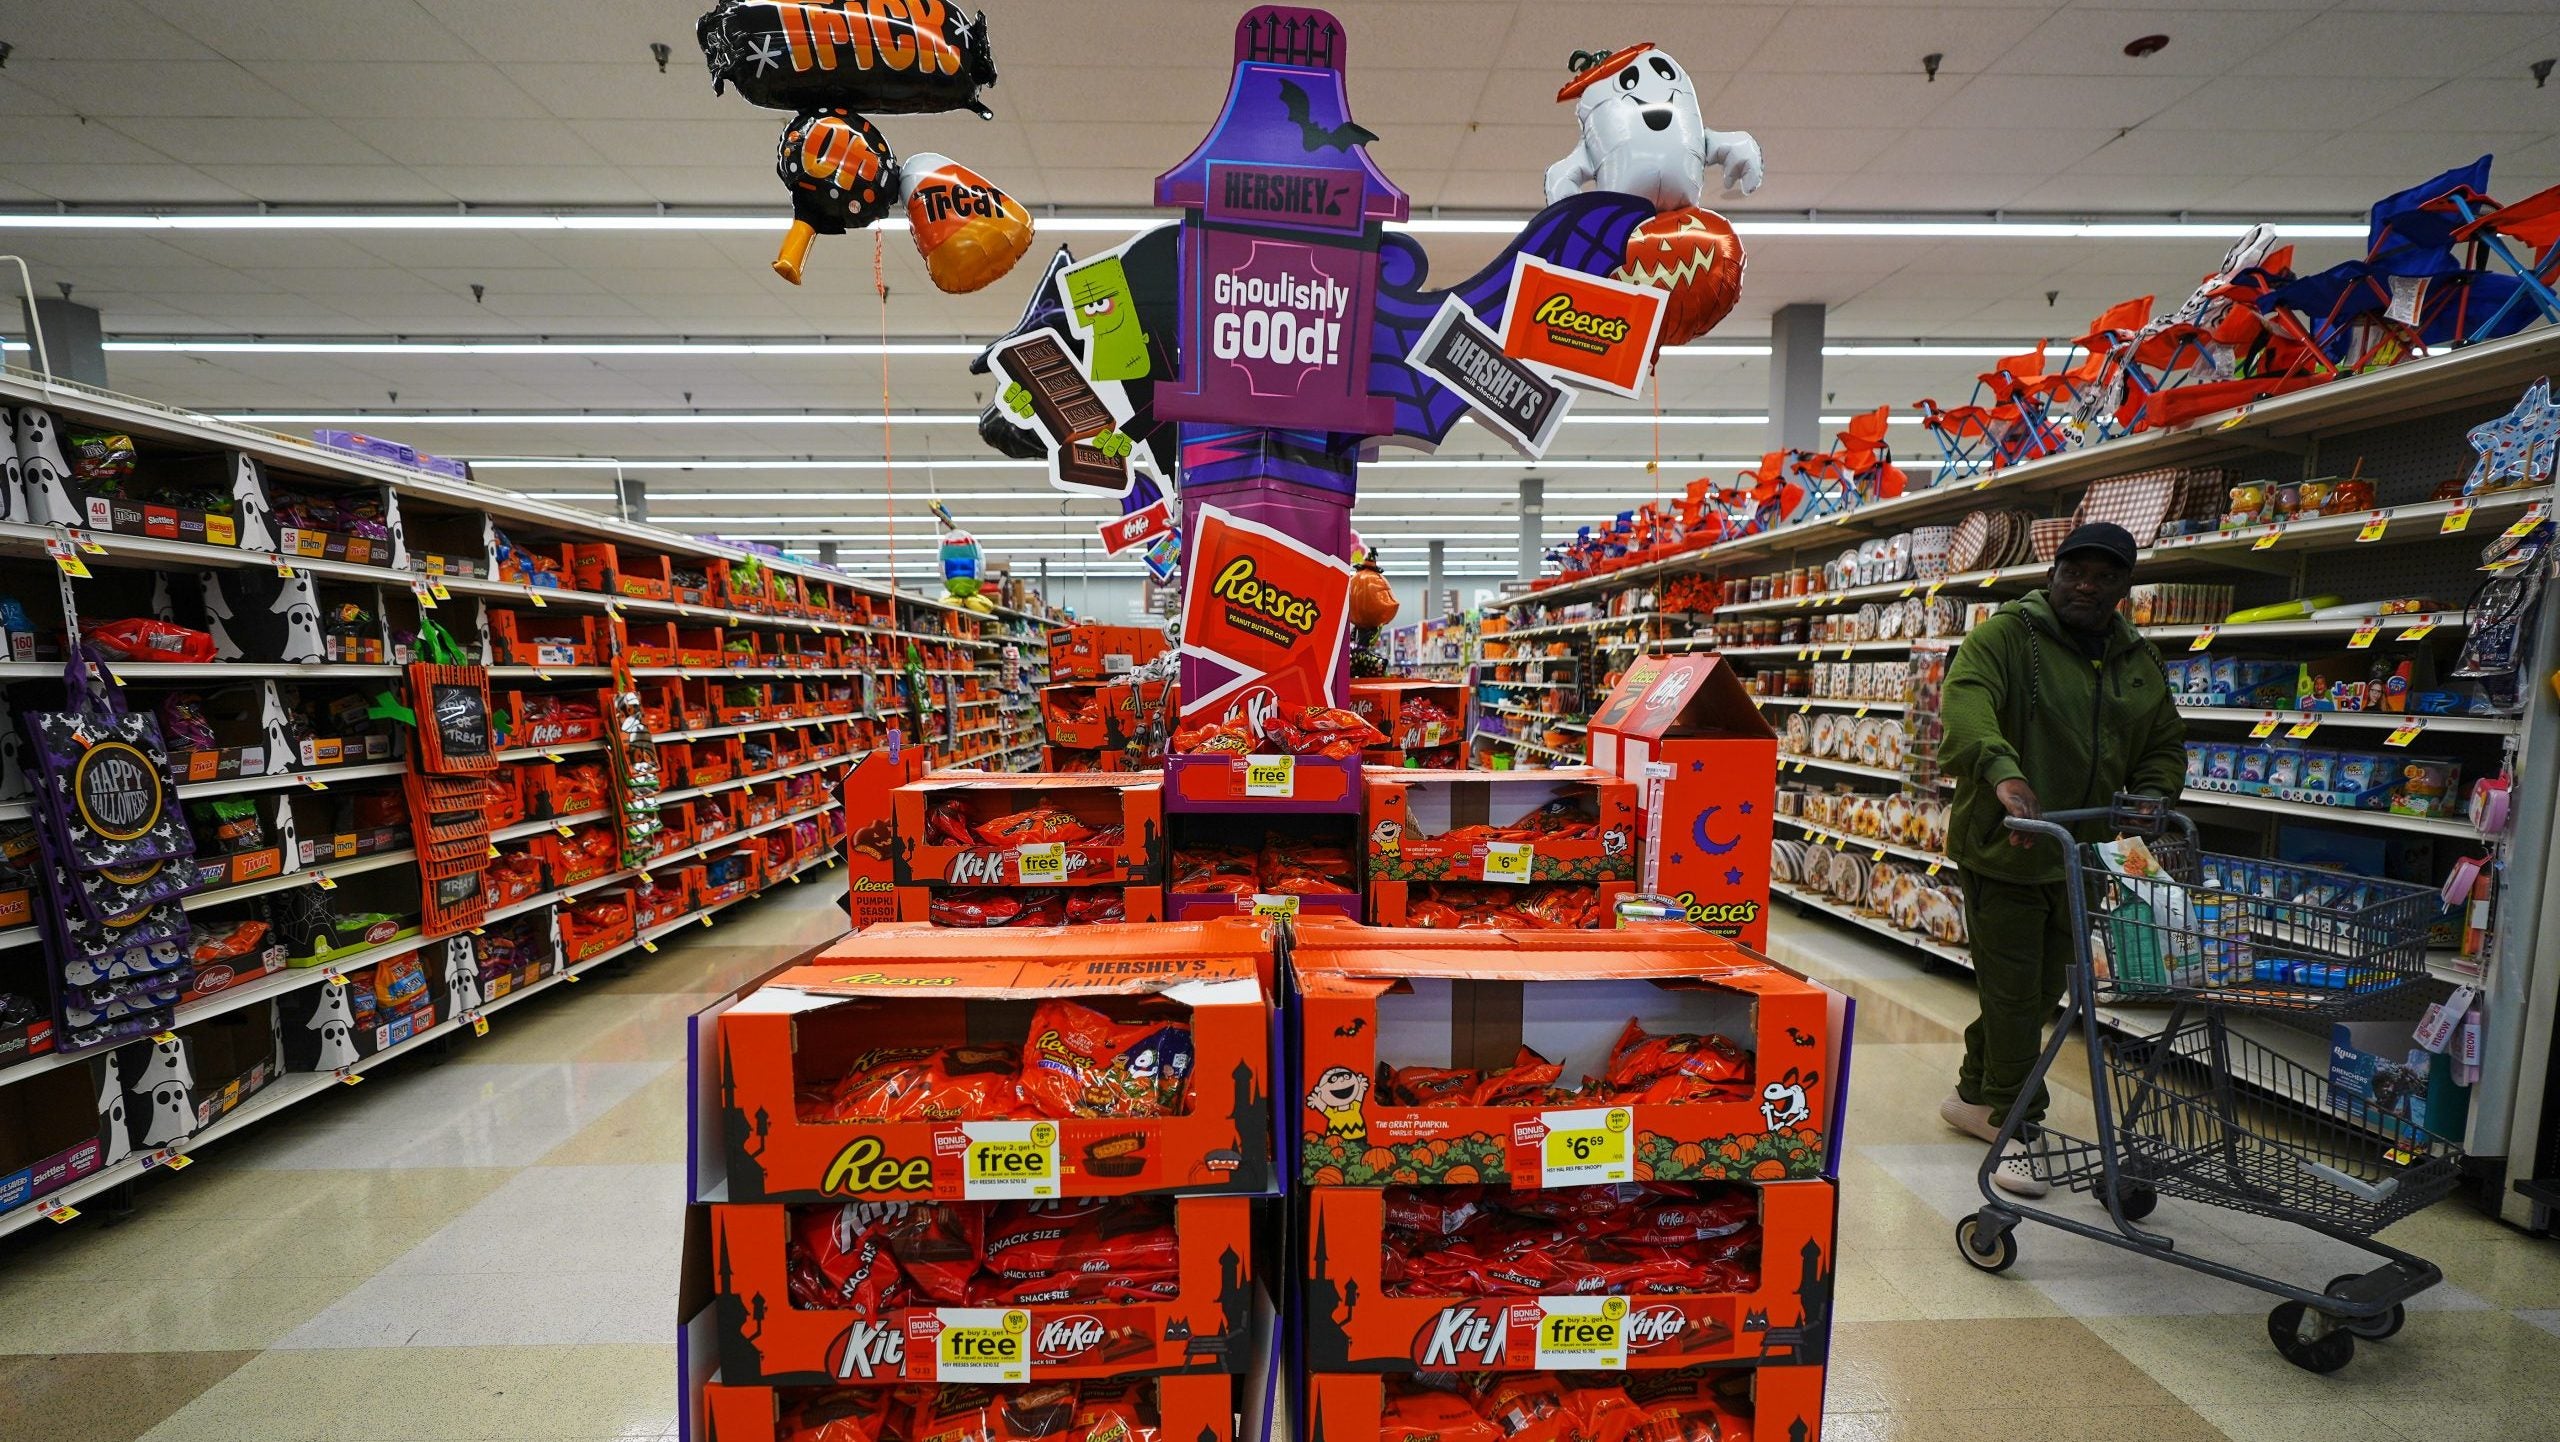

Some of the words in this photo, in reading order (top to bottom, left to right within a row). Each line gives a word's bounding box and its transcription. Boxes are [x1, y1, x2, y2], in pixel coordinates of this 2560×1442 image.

[1224, 172, 1328, 215] HERSHEY
[1215, 271, 1349, 319] Ghoulishly
[1534, 294, 1630, 342] Reese's
[1551, 334, 1572, 345] PEANUT
[1571, 338, 1591, 349] BUTTER
[1591, 344, 1604, 352] CUPS
[1446, 333, 1543, 421] HERSHEY'S
[1461, 374, 1477, 388] milk
[1476, 384, 1505, 409] chocolate
[91, 502, 106, 515] 40
[148, 515, 175, 526] Skittles
[284, 532, 295, 543] 35
[1212, 557, 1318, 632] Reese's
[1229, 614, 1252, 630] PEANUT
[1251, 621, 1275, 637] BUTTER
[1273, 631, 1291, 644] CUPS
[14, 636, 33, 650] 160
[302, 744, 313, 754] 35
[193, 760, 214, 772] Twix
[1253, 768, 1286, 781] free
[89, 758, 143, 794] HAPPY
[90, 790, 149, 825] HALLOWEEN
[300, 842, 313, 853] 120
[241, 853, 272, 871] Twix
[1025, 857, 1059, 870] free
[853, 876, 894, 893] Reese
[0, 900, 24, 915] wix
[1087, 959, 1206, 975] HERSHEY'S
[832, 973, 959, 986] Reese's
[30, 1027, 54, 1045] Skittl
[2431, 1022, 2450, 1047] meow
[2466, 1031, 2476, 1058] meow
[2331, 1065, 2369, 1084] DRENCHERS
[1375, 1120, 1388, 1129] THE
[1388, 1120, 1413, 1129] GREAT
[1517, 1126, 1544, 1136] BONUS
[937, 1136, 966, 1146] BONUS
[977, 1147, 1044, 1172] free
[33, 1163, 67, 1186] Skittles
[988, 1231, 1030, 1255] SNACK
[1032, 1229, 1061, 1239] SIZE
[1003, 1270, 1027, 1279] SNACK
[1028, 1270, 1046, 1278] SIZE
[1523, 1278, 1541, 1288] SIZE
[1020, 1293, 1050, 1304] SNACK
[1050, 1290, 1070, 1300] SIZE
[1513, 1309, 1540, 1318] BONUS
[911, 1320, 940, 1330] BONUS
[1551, 1319, 1614, 1342] free
[951, 1332, 1016, 1356] free
[1038, 1321, 1104, 1352] KitKat
[838, 1320, 906, 1379] Kit
